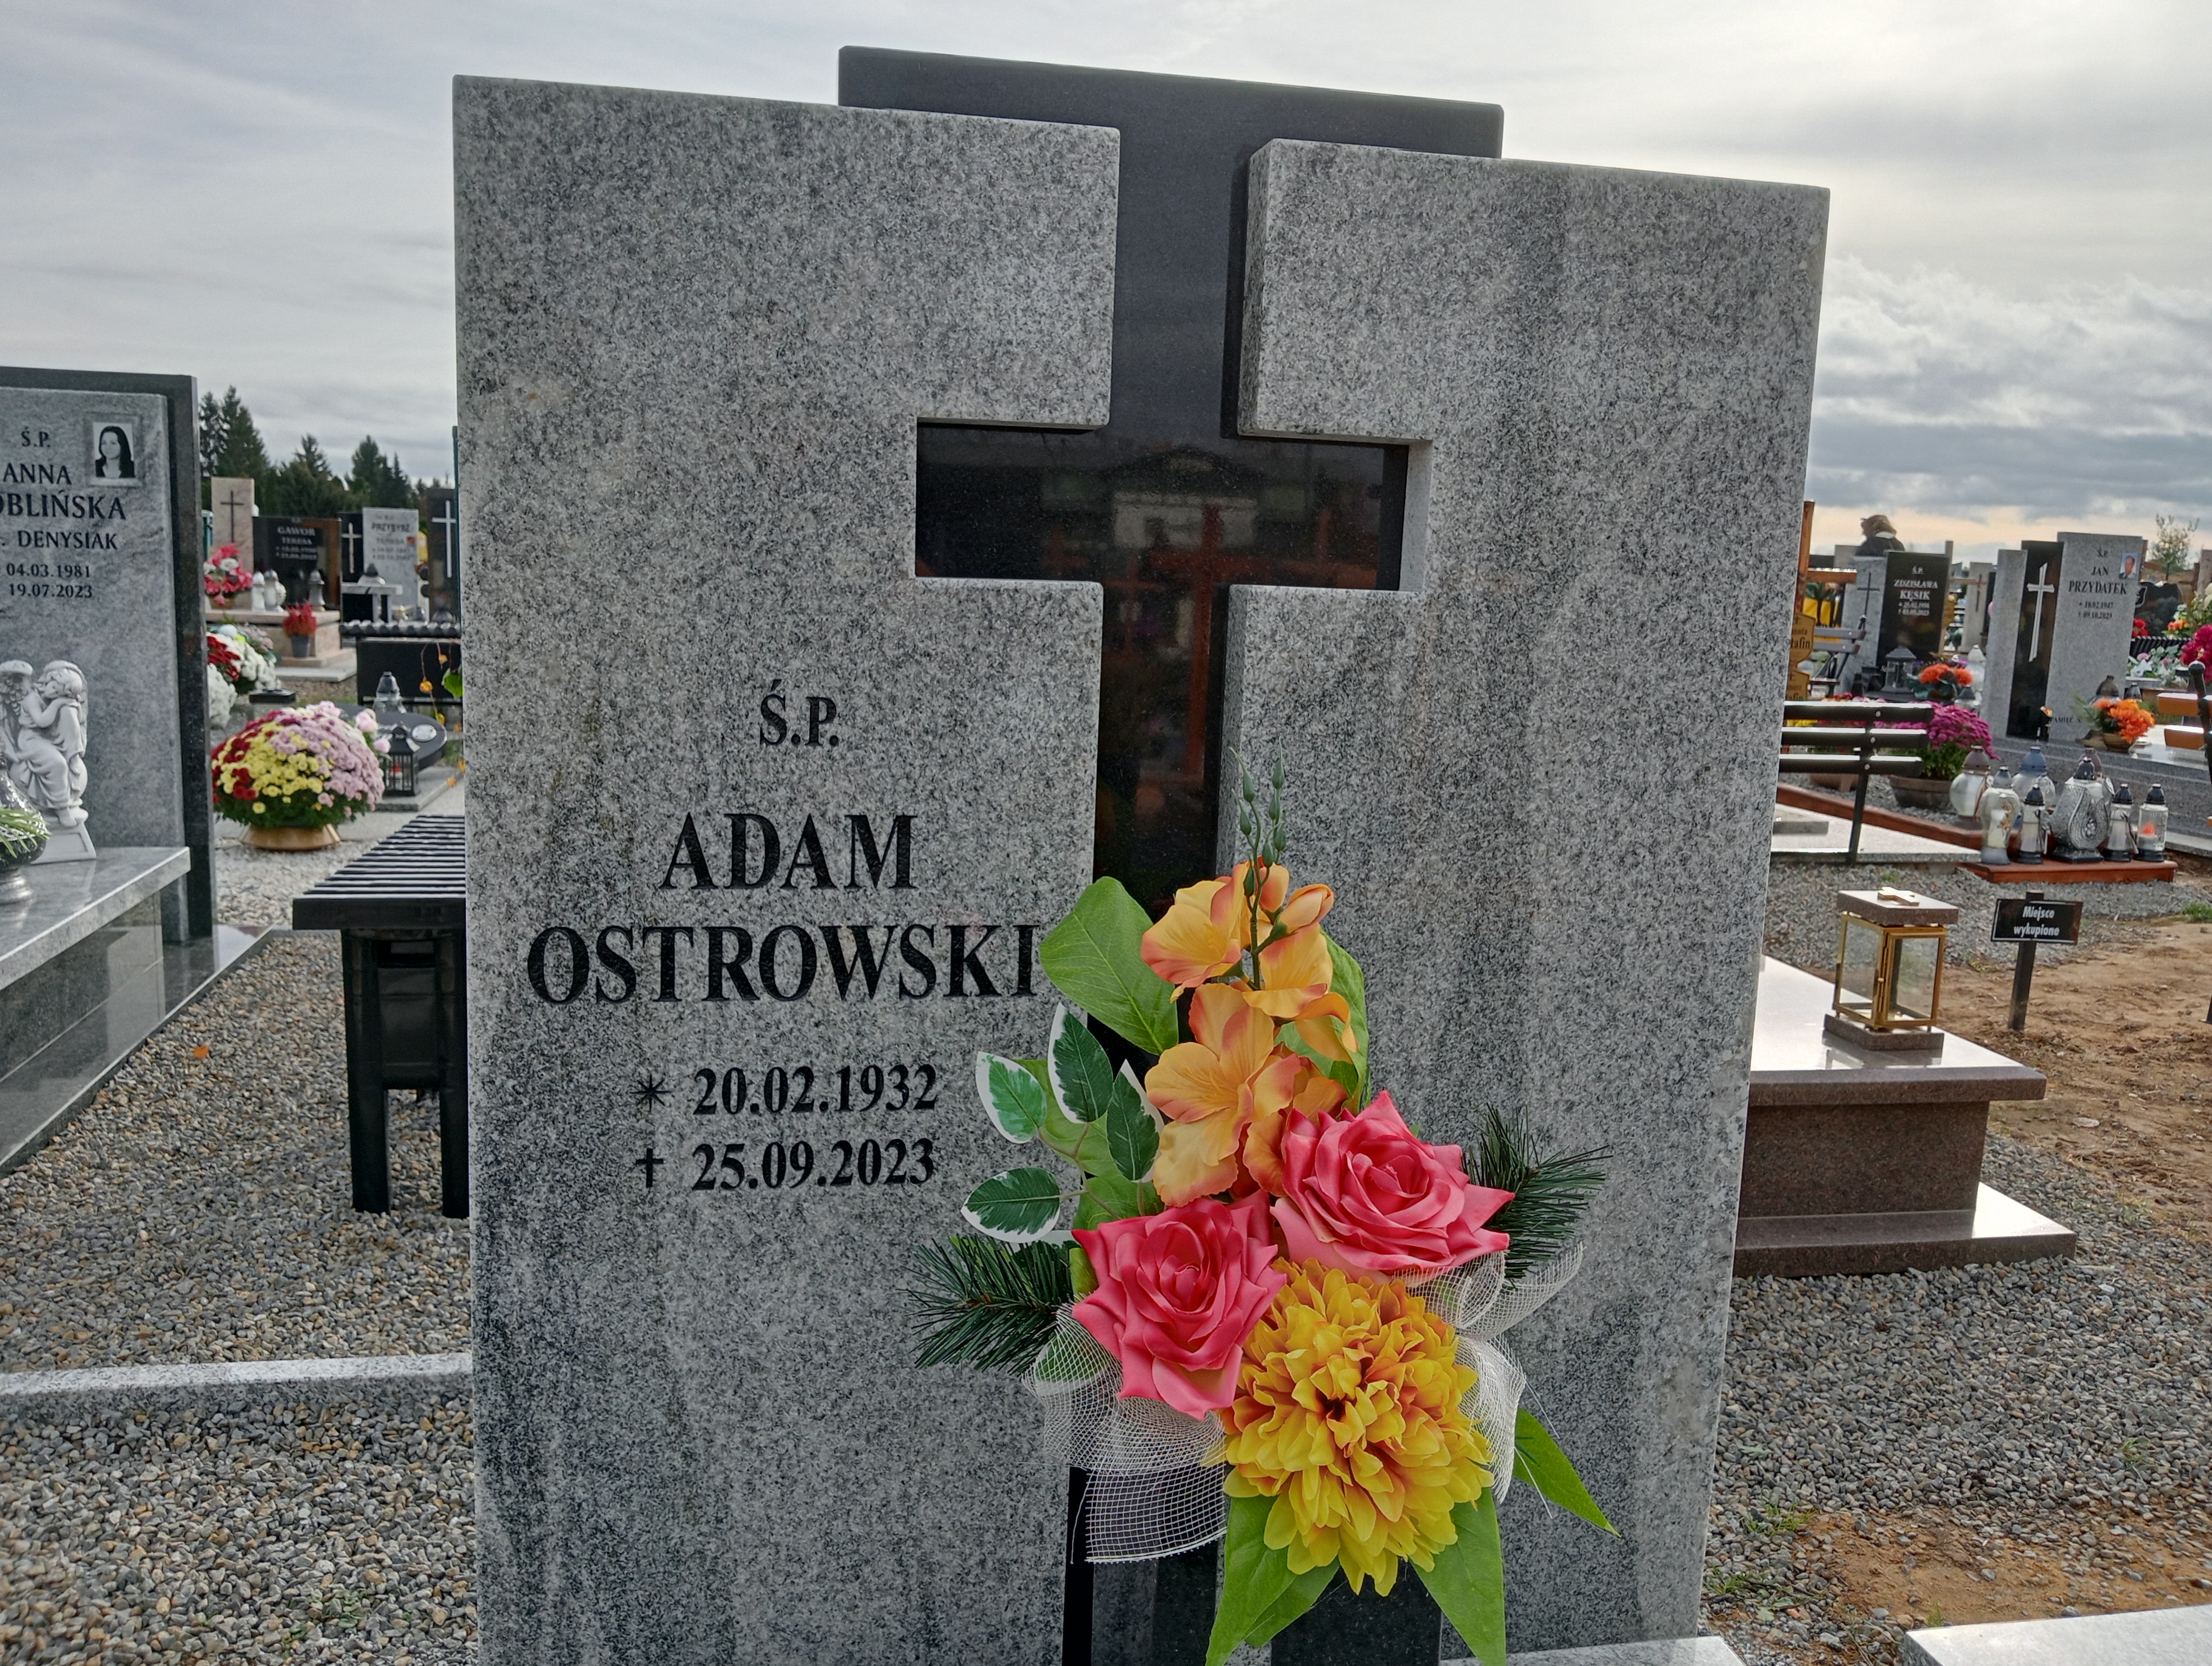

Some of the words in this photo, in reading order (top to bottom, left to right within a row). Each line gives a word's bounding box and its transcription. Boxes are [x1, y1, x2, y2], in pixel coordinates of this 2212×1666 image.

[21, 427, 50, 447] Ś.P.
[3, 463, 72, 485] ANNA
[18, 530, 118, 550] DENYSIAK
[7, 563, 90, 578] 04.03.1981
[2091, 566, 2108, 576] JAN
[9, 584, 92, 598] 19.07.2023
[2069, 580, 2127, 594] PRZYDATEK
[760, 679, 839, 747] Ś.P.
[2052, 715, 2073, 726] AMIĘĆ
[658, 811, 918, 890] ADAM
[2022, 906, 2055, 921] Miejsce
[2014, 922, 2060, 938] wykupione
[526, 924, 1040, 1005] OSTROWSKI
[691, 1063, 937, 1115] 20.02.1932
[691, 1137, 936, 1191] 25.09.2023
